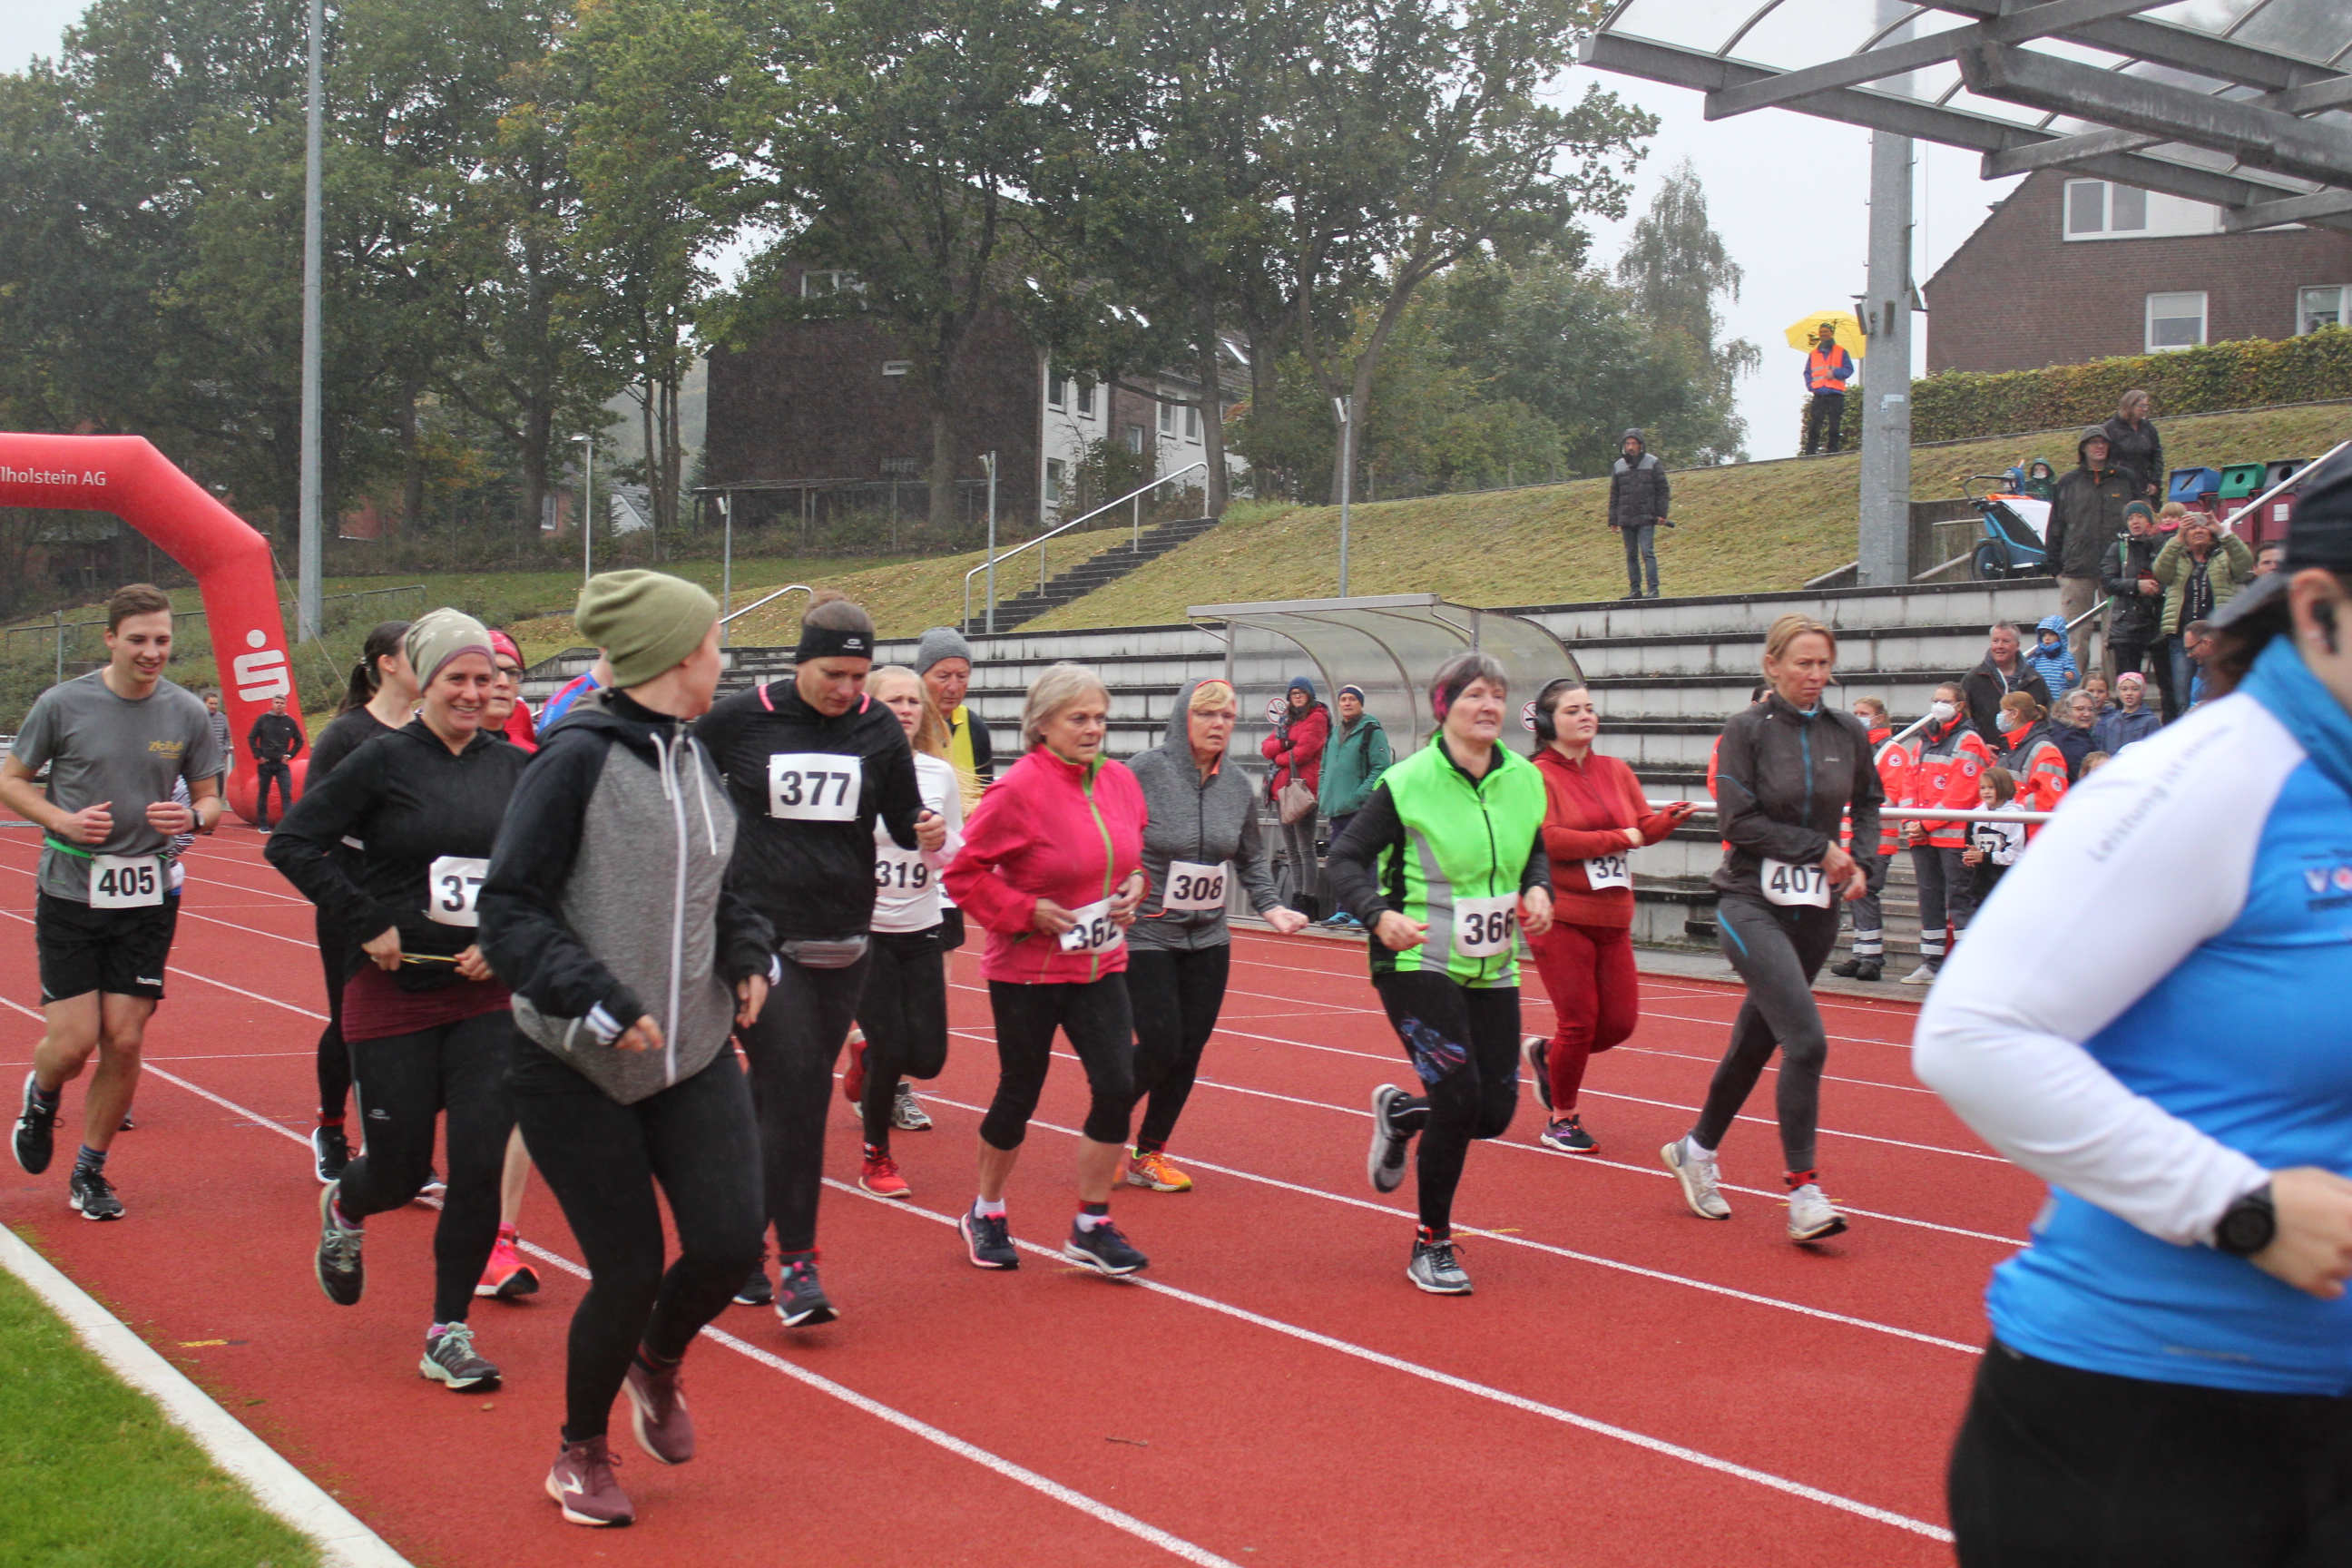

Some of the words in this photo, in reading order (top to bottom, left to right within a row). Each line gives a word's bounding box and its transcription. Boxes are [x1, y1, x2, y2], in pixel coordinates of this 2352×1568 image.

[81, 471, 107, 485] AG
[780, 770, 851, 806] 377
[98, 865, 154, 897] 405
[875, 860, 927, 888] 319
[1173, 874, 1223, 901] 308
[1770, 866, 1825, 895] 407
[1464, 907, 1515, 946] 366
